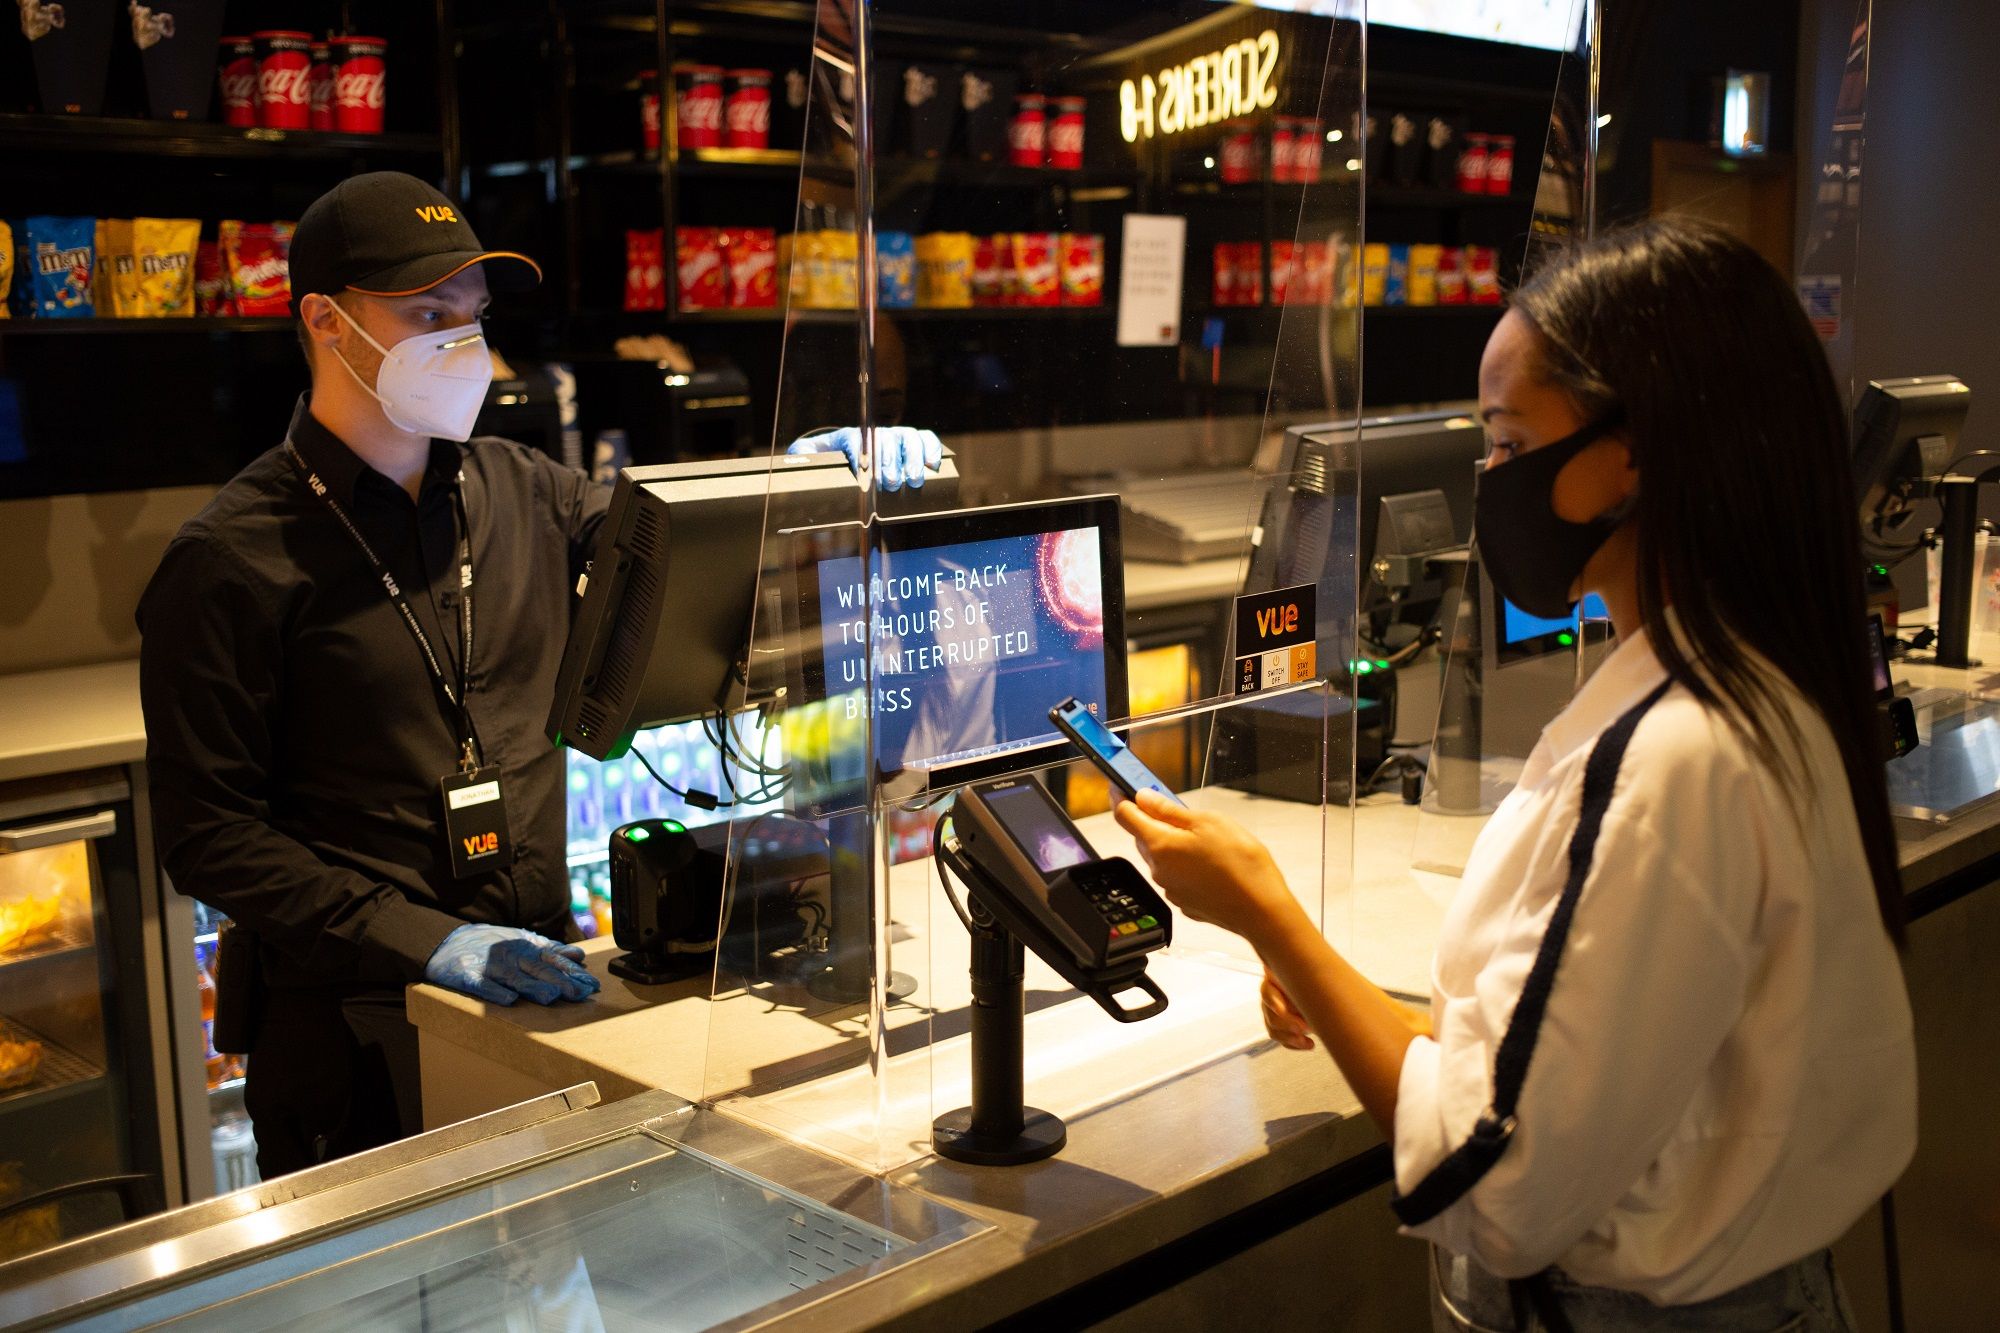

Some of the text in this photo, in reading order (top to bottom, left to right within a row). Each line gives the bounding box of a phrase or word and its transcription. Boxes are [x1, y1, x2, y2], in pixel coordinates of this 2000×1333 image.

[308, 473, 327, 496] vue
[382, 572, 400, 597] vue
[955, 563, 1007, 592] BACK
[839, 601, 989, 646] TO HOURS OF
[1256, 603, 1299, 638] vue
[1267, 667, 1285, 678] SWITCH
[1297, 661, 1308, 670] STAY
[1297, 670, 1308, 679] SAFE
[1241, 683, 1255, 692] BACK
[463, 831, 499, 856] vue
